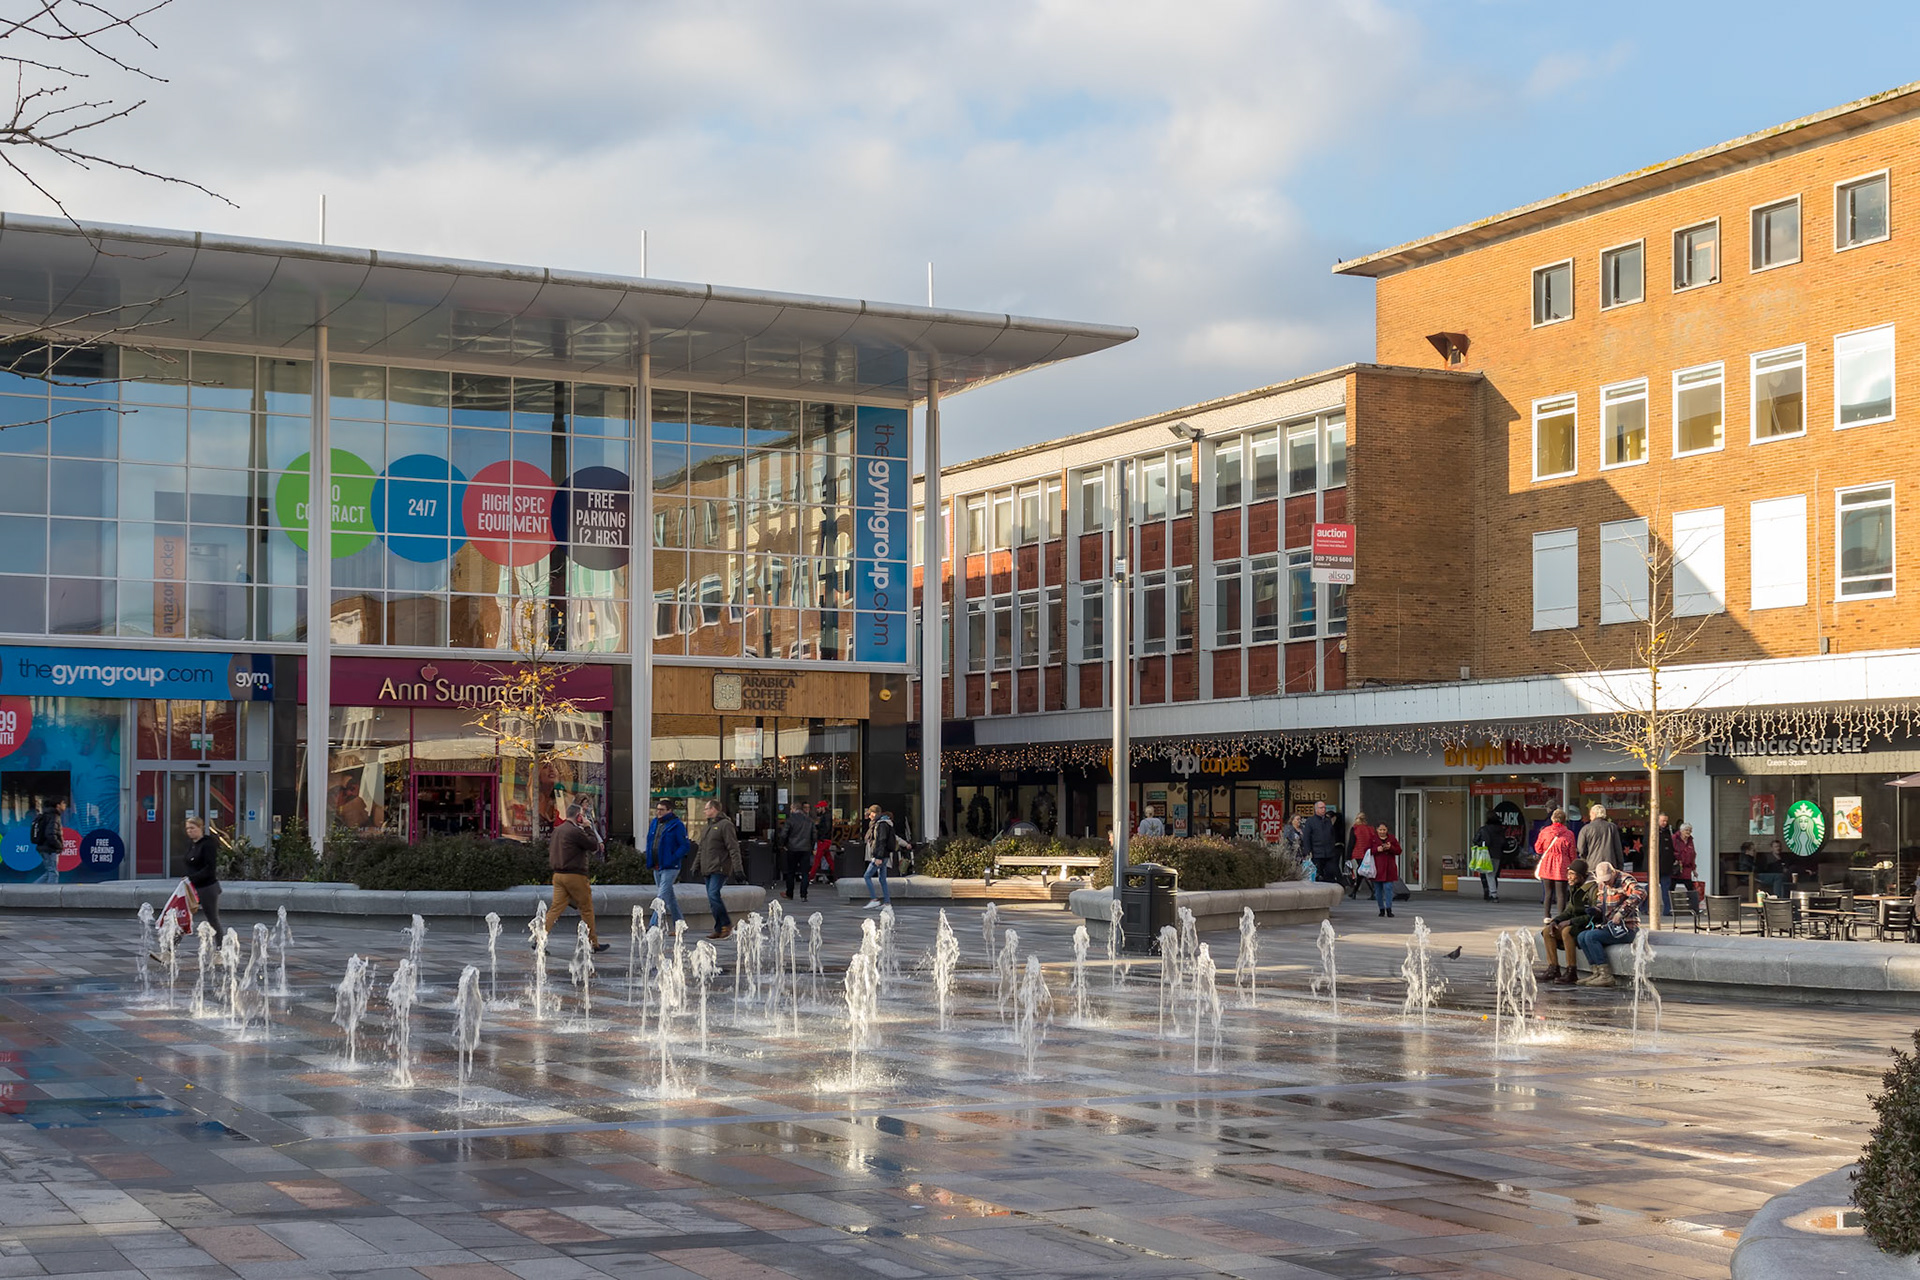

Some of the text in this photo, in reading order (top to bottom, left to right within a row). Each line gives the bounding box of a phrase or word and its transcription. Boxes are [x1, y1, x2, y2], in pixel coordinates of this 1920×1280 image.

[408, 499, 437, 517] 24/7
[481, 493, 545, 514] HIGH SPEC
[588, 492, 615, 509] FREE
[477, 513, 549, 534] EQUIPMENT
[576, 509, 626, 528] PARKING
[595, 531, 623, 546] HRS)
[867, 423, 895, 646] thegymgroup.com
[1316, 528, 1346, 538] auction
[1328, 571, 1351, 581] allsop
[19, 658, 213, 687] thegymgroup.com
[235, 672, 270, 688] gym
[378, 677, 542, 703] Ann Summers
[743, 676, 796, 689] ARABICA
[743, 688, 788, 700] COFFEE
[743, 700, 785, 711] HOUSE
[1706, 738, 1862, 757] STARBUCKS COFFEE
[1201, 753, 1250, 777] carpets
[1766, 759, 1808, 768] Queens Square
[1260, 804, 1280, 820] 50%
[1296, 805, 1314, 816] FREE
[1260, 820, 1280, 834] OFF
[16, 843, 29, 853] 24/7
[90, 846, 114, 854] PARKING
[96, 838, 109, 847] FREE
[99, 854, 113, 863] HRS)
